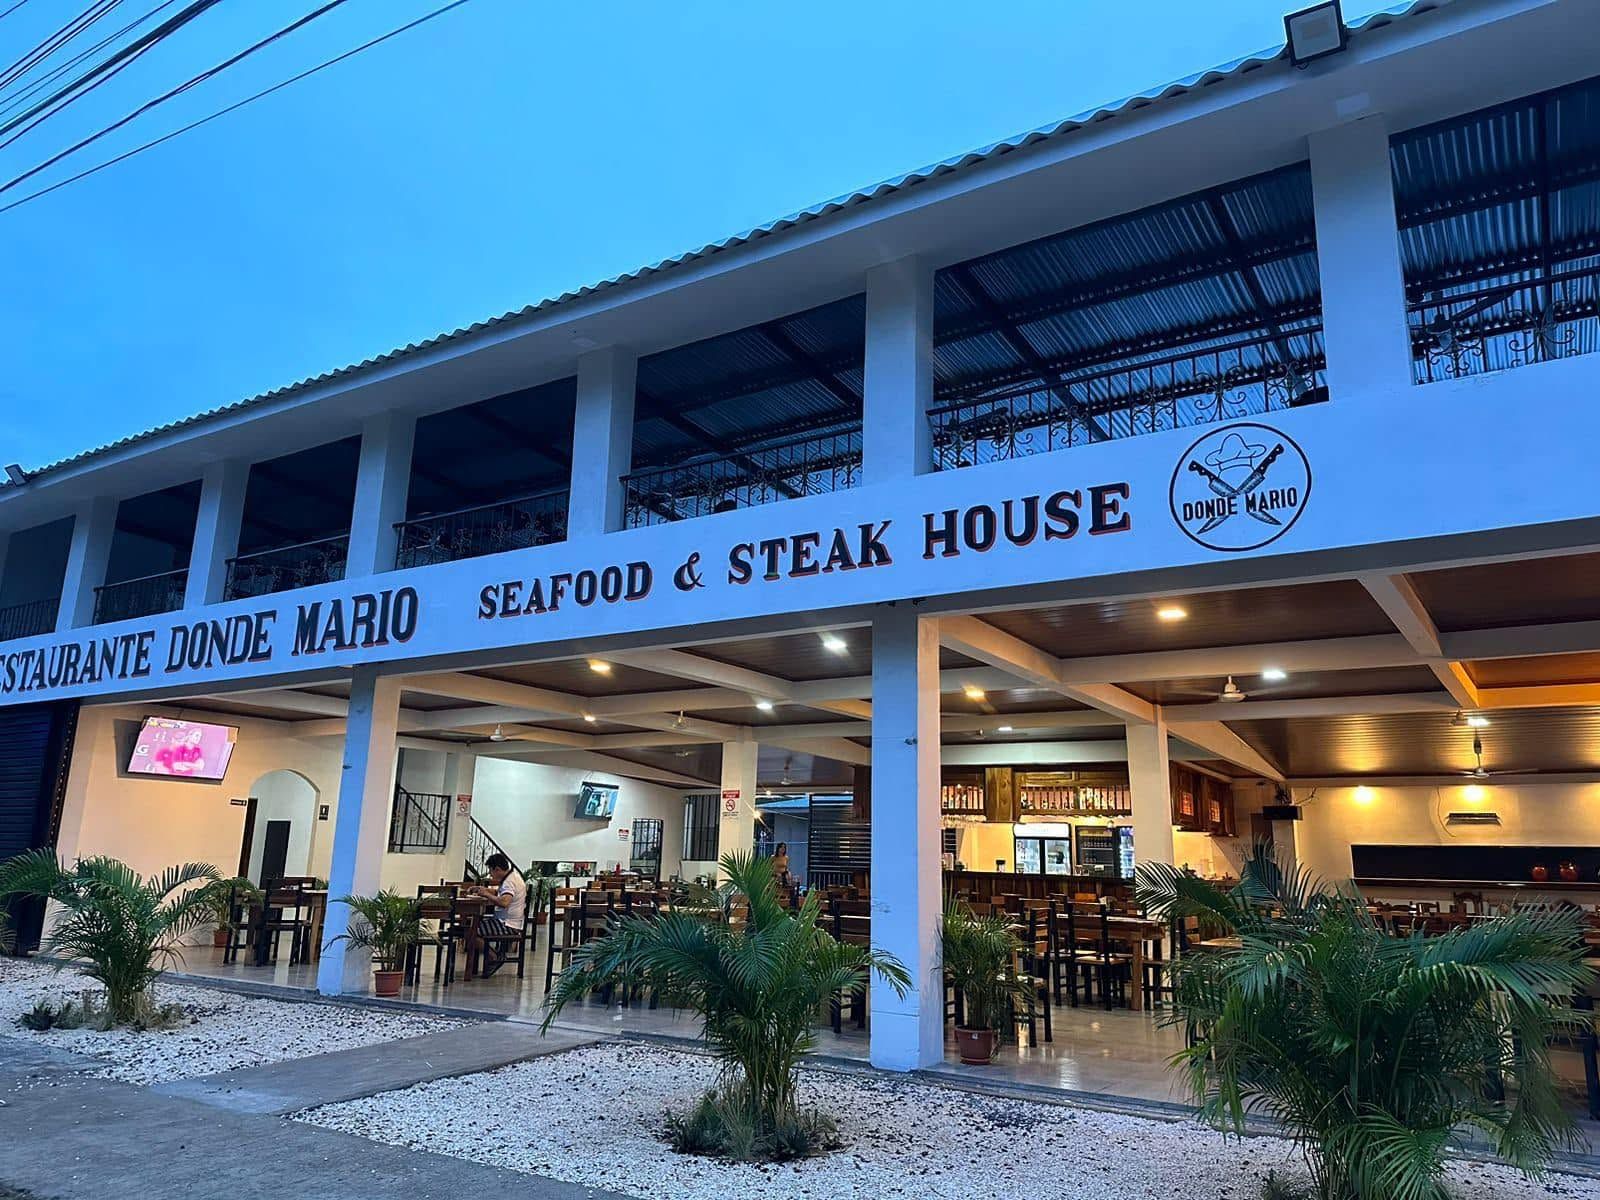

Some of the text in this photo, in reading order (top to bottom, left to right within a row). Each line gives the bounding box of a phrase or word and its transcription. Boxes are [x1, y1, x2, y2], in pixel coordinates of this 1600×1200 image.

[1183, 487, 1298, 521] DONDE MARIO
[165, 610, 277, 673] DONDE
[291, 587, 419, 656] MARIO
[478, 561, 653, 619] SEAFOOD
[673, 552, 705, 591] &
[728, 520, 893, 584] STEAK
[922, 482, 1131, 559] HOUSE
